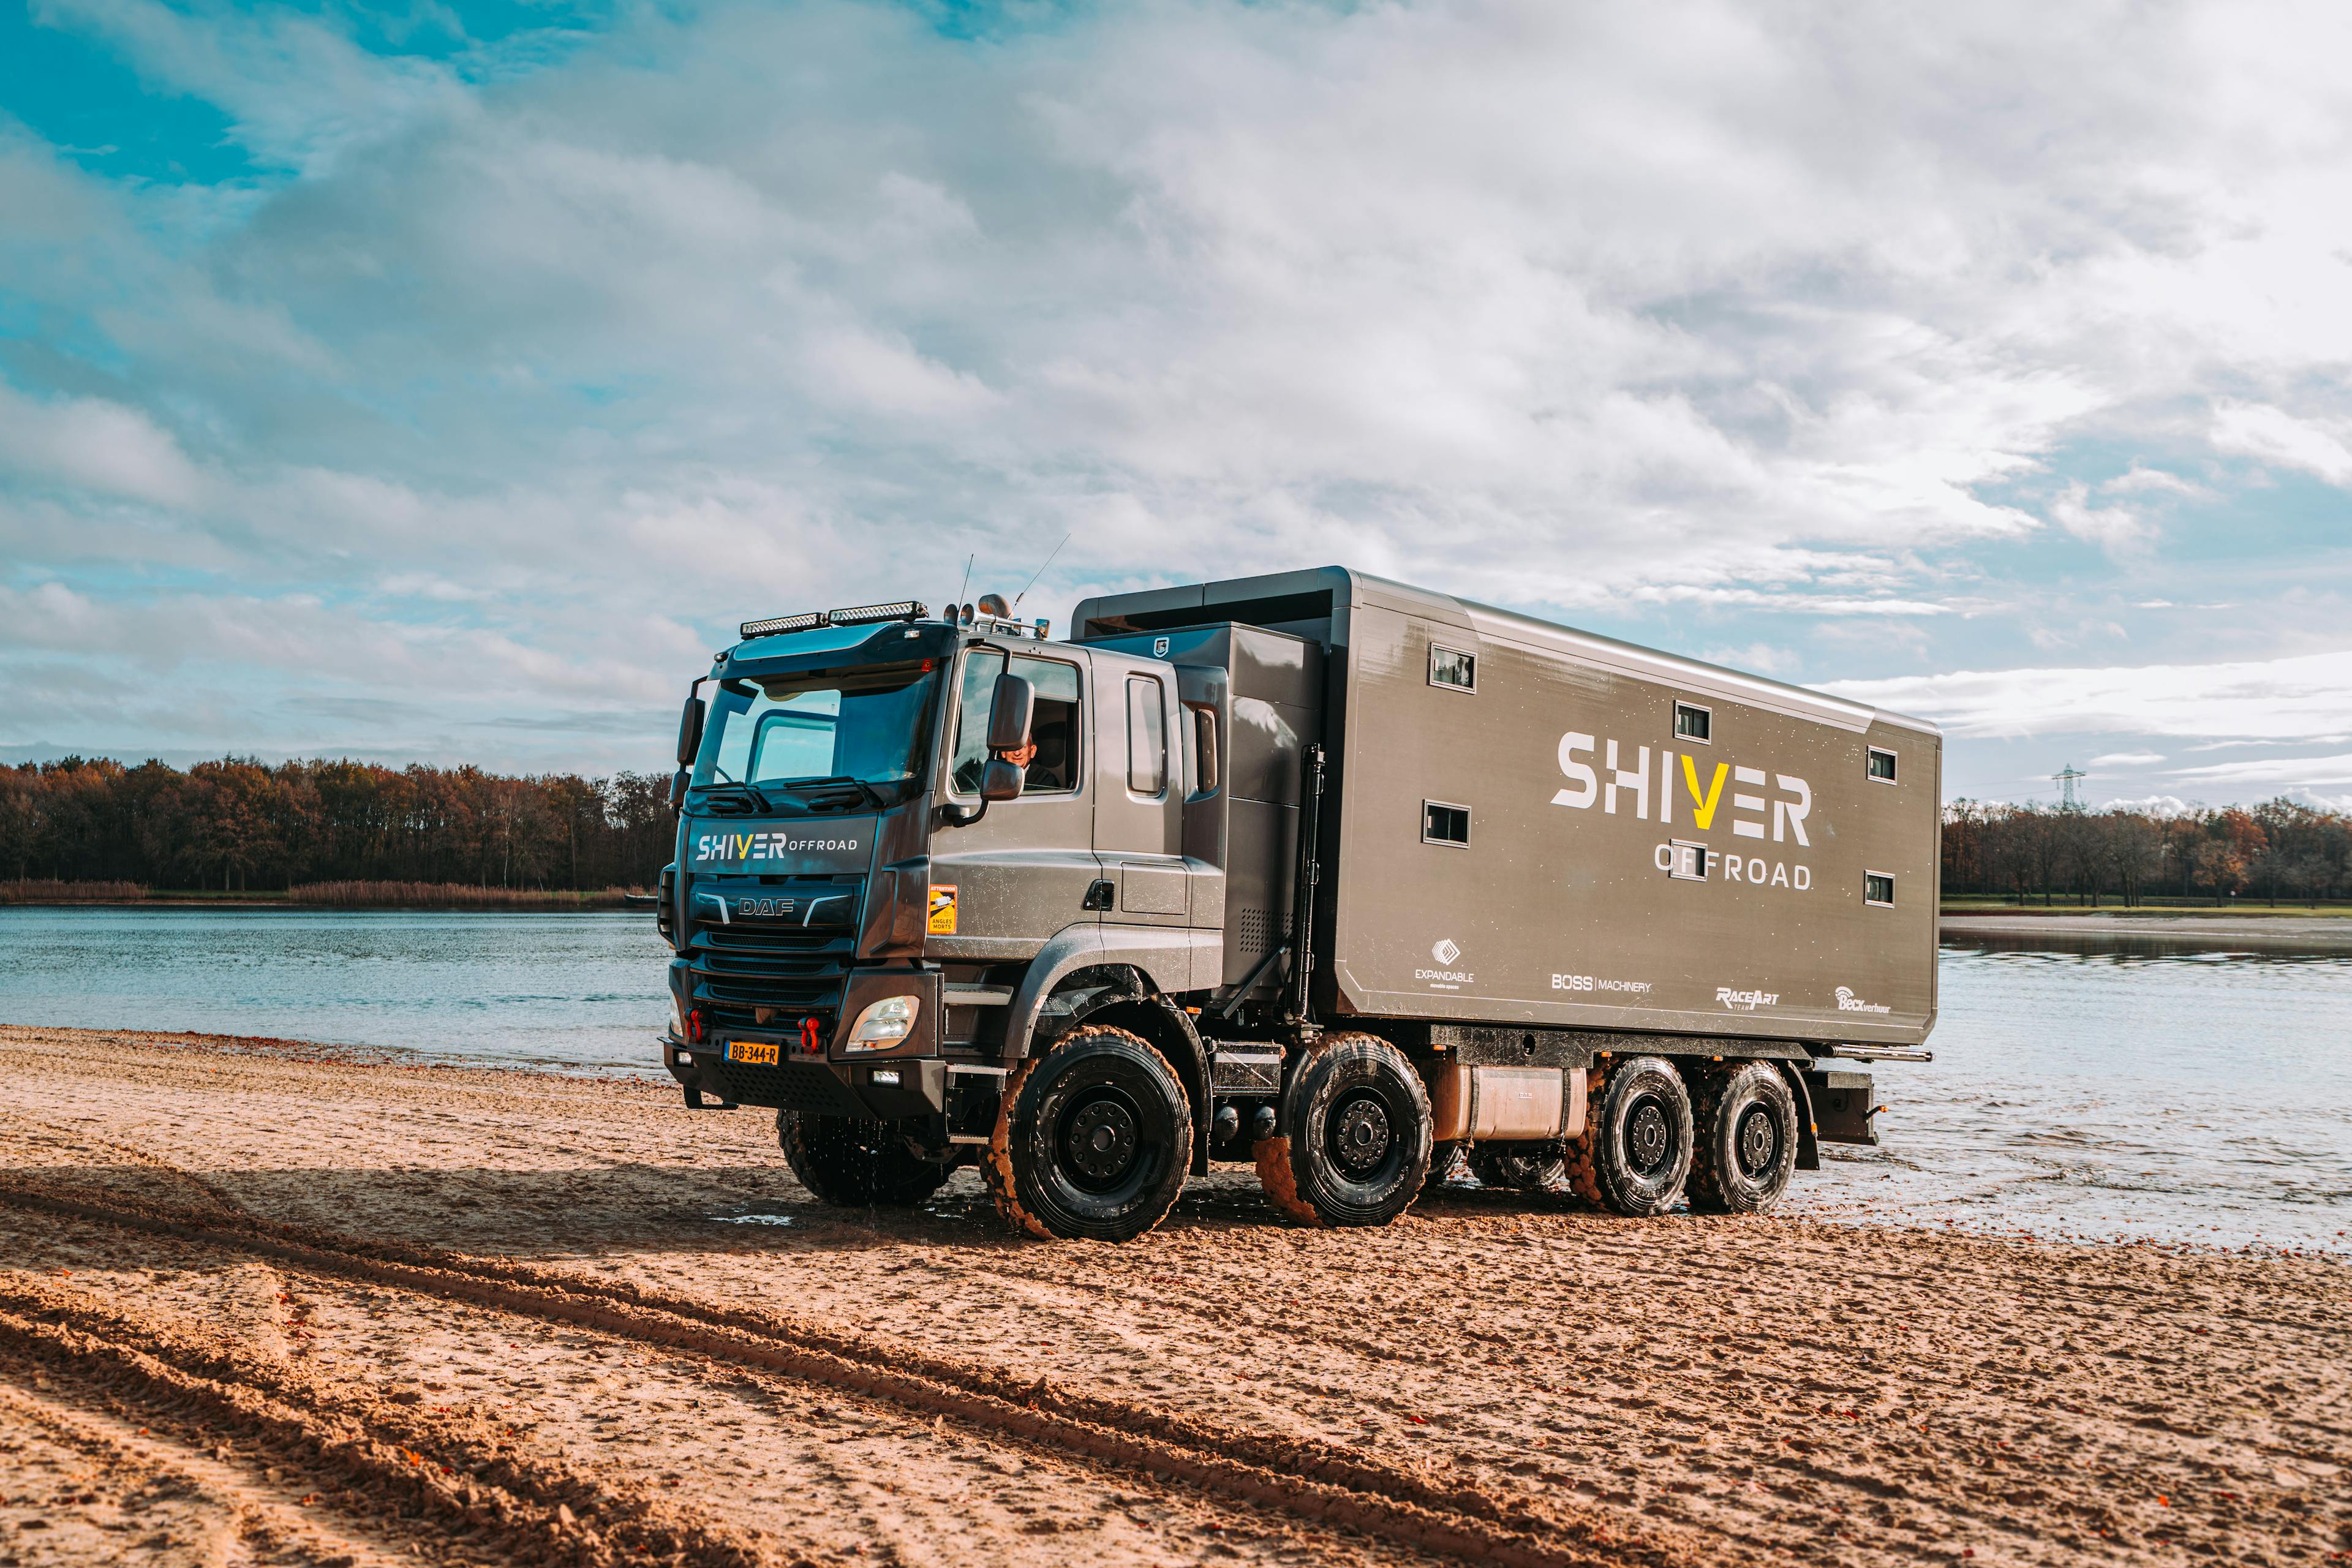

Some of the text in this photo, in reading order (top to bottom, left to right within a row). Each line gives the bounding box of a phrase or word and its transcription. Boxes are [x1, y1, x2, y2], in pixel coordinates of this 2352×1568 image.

[1550, 731, 1811, 846] SHIVER
[695, 833, 858, 860] SHIVER OFFROAD
[1654, 843, 1811, 890] OFFROAD
[739, 898, 794, 916] DAF
[1415, 969, 1474, 982] EXPANDABLE
[1551, 973, 1652, 993] BOSS MACHINERY
[732, 1045, 776, 1063] BB-344-R
